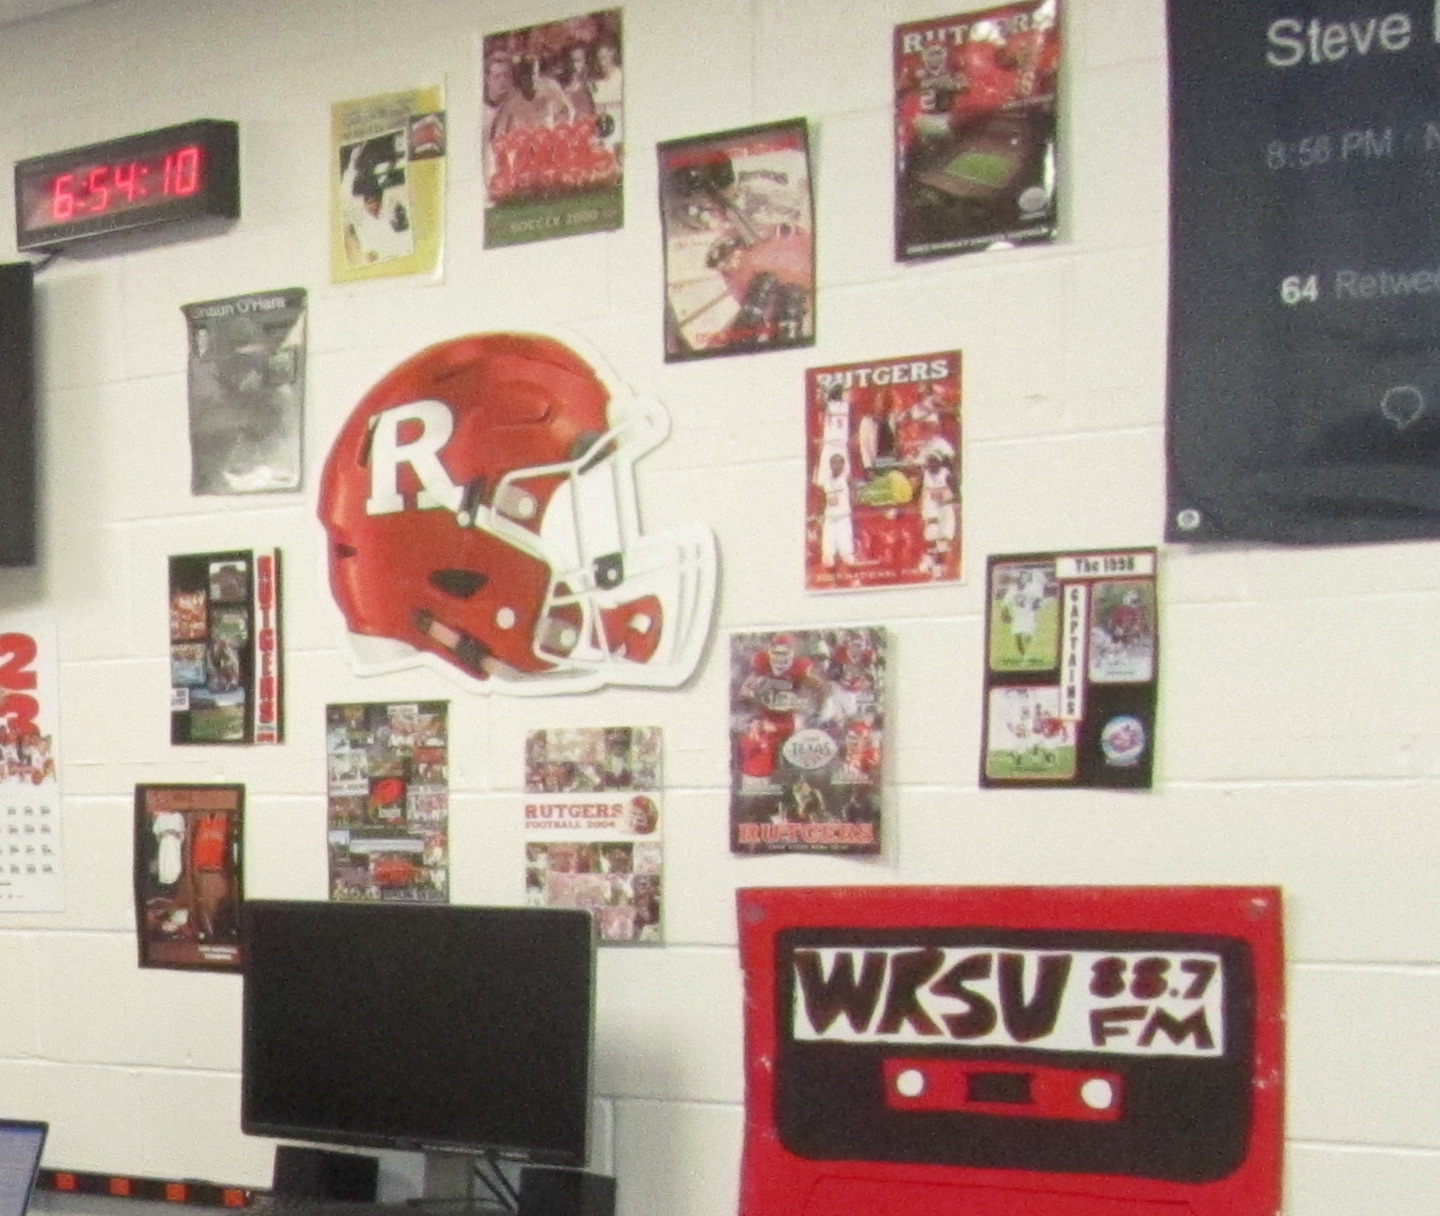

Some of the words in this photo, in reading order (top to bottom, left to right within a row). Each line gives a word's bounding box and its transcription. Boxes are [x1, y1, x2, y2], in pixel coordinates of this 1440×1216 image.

[1266, 13, 1412, 67] Steve
[1342, 128, 1393, 160] PM
[52, 147, 201, 221] 6:54:10
[1280, 274, 1319, 304] 64
[816, 359, 949, 389] RUTGERS
[366, 399, 465, 516] R
[525, 803, 624, 819] RUTGERS
[738, 822, 875, 844] RUTGERS
[794, 946, 1072, 1043] WRSU
[1089, 955, 1218, 1000] 88.7
[1089, 1004, 1216, 1049] FM
